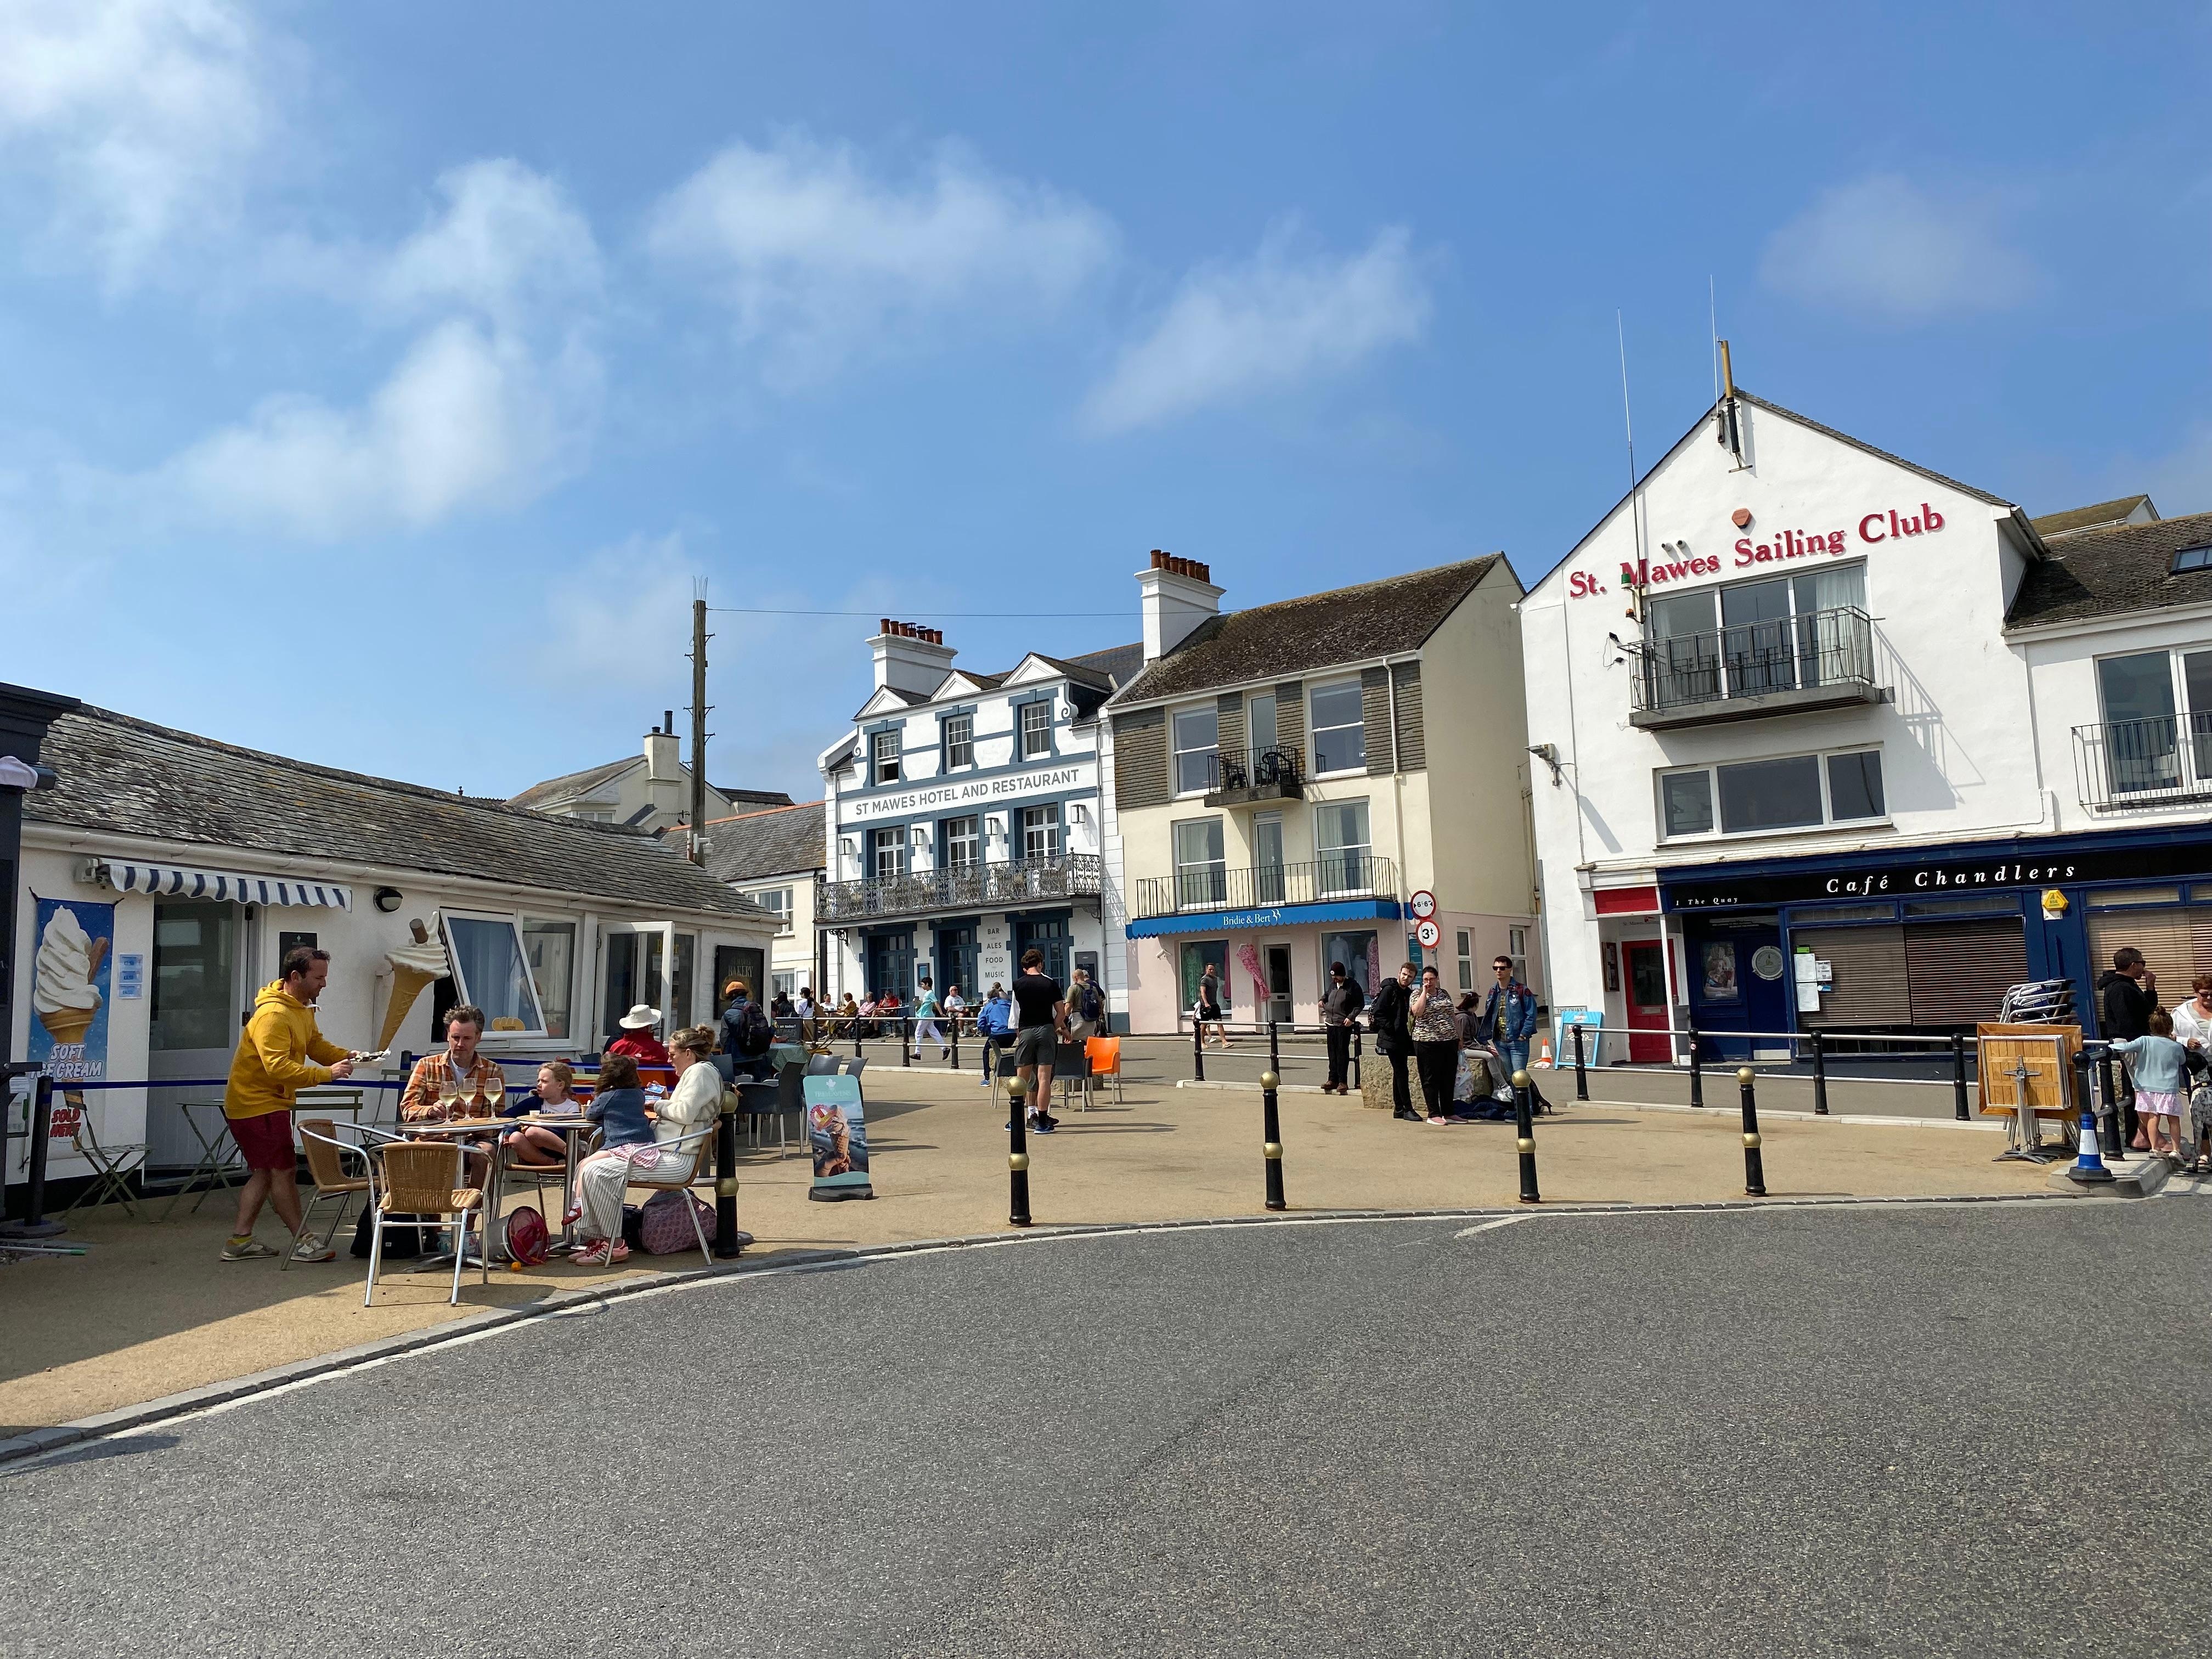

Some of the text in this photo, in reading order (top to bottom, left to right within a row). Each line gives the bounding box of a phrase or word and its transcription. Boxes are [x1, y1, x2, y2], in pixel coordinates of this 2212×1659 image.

[1570, 503, 1943, 597] St. Mawes Sailing Club
[856, 769, 1079, 816] ST MAWES HOTEL AND RESTAURANT
[1826, 865, 2075, 895] Café Chandlers
[1223, 913, 1271, 926] Bridie & Bert
[728, 965, 753, 977] BAKERY
[50, 1043, 86, 1060] SOFT
[56, 1060, 103, 1079] CREAM
